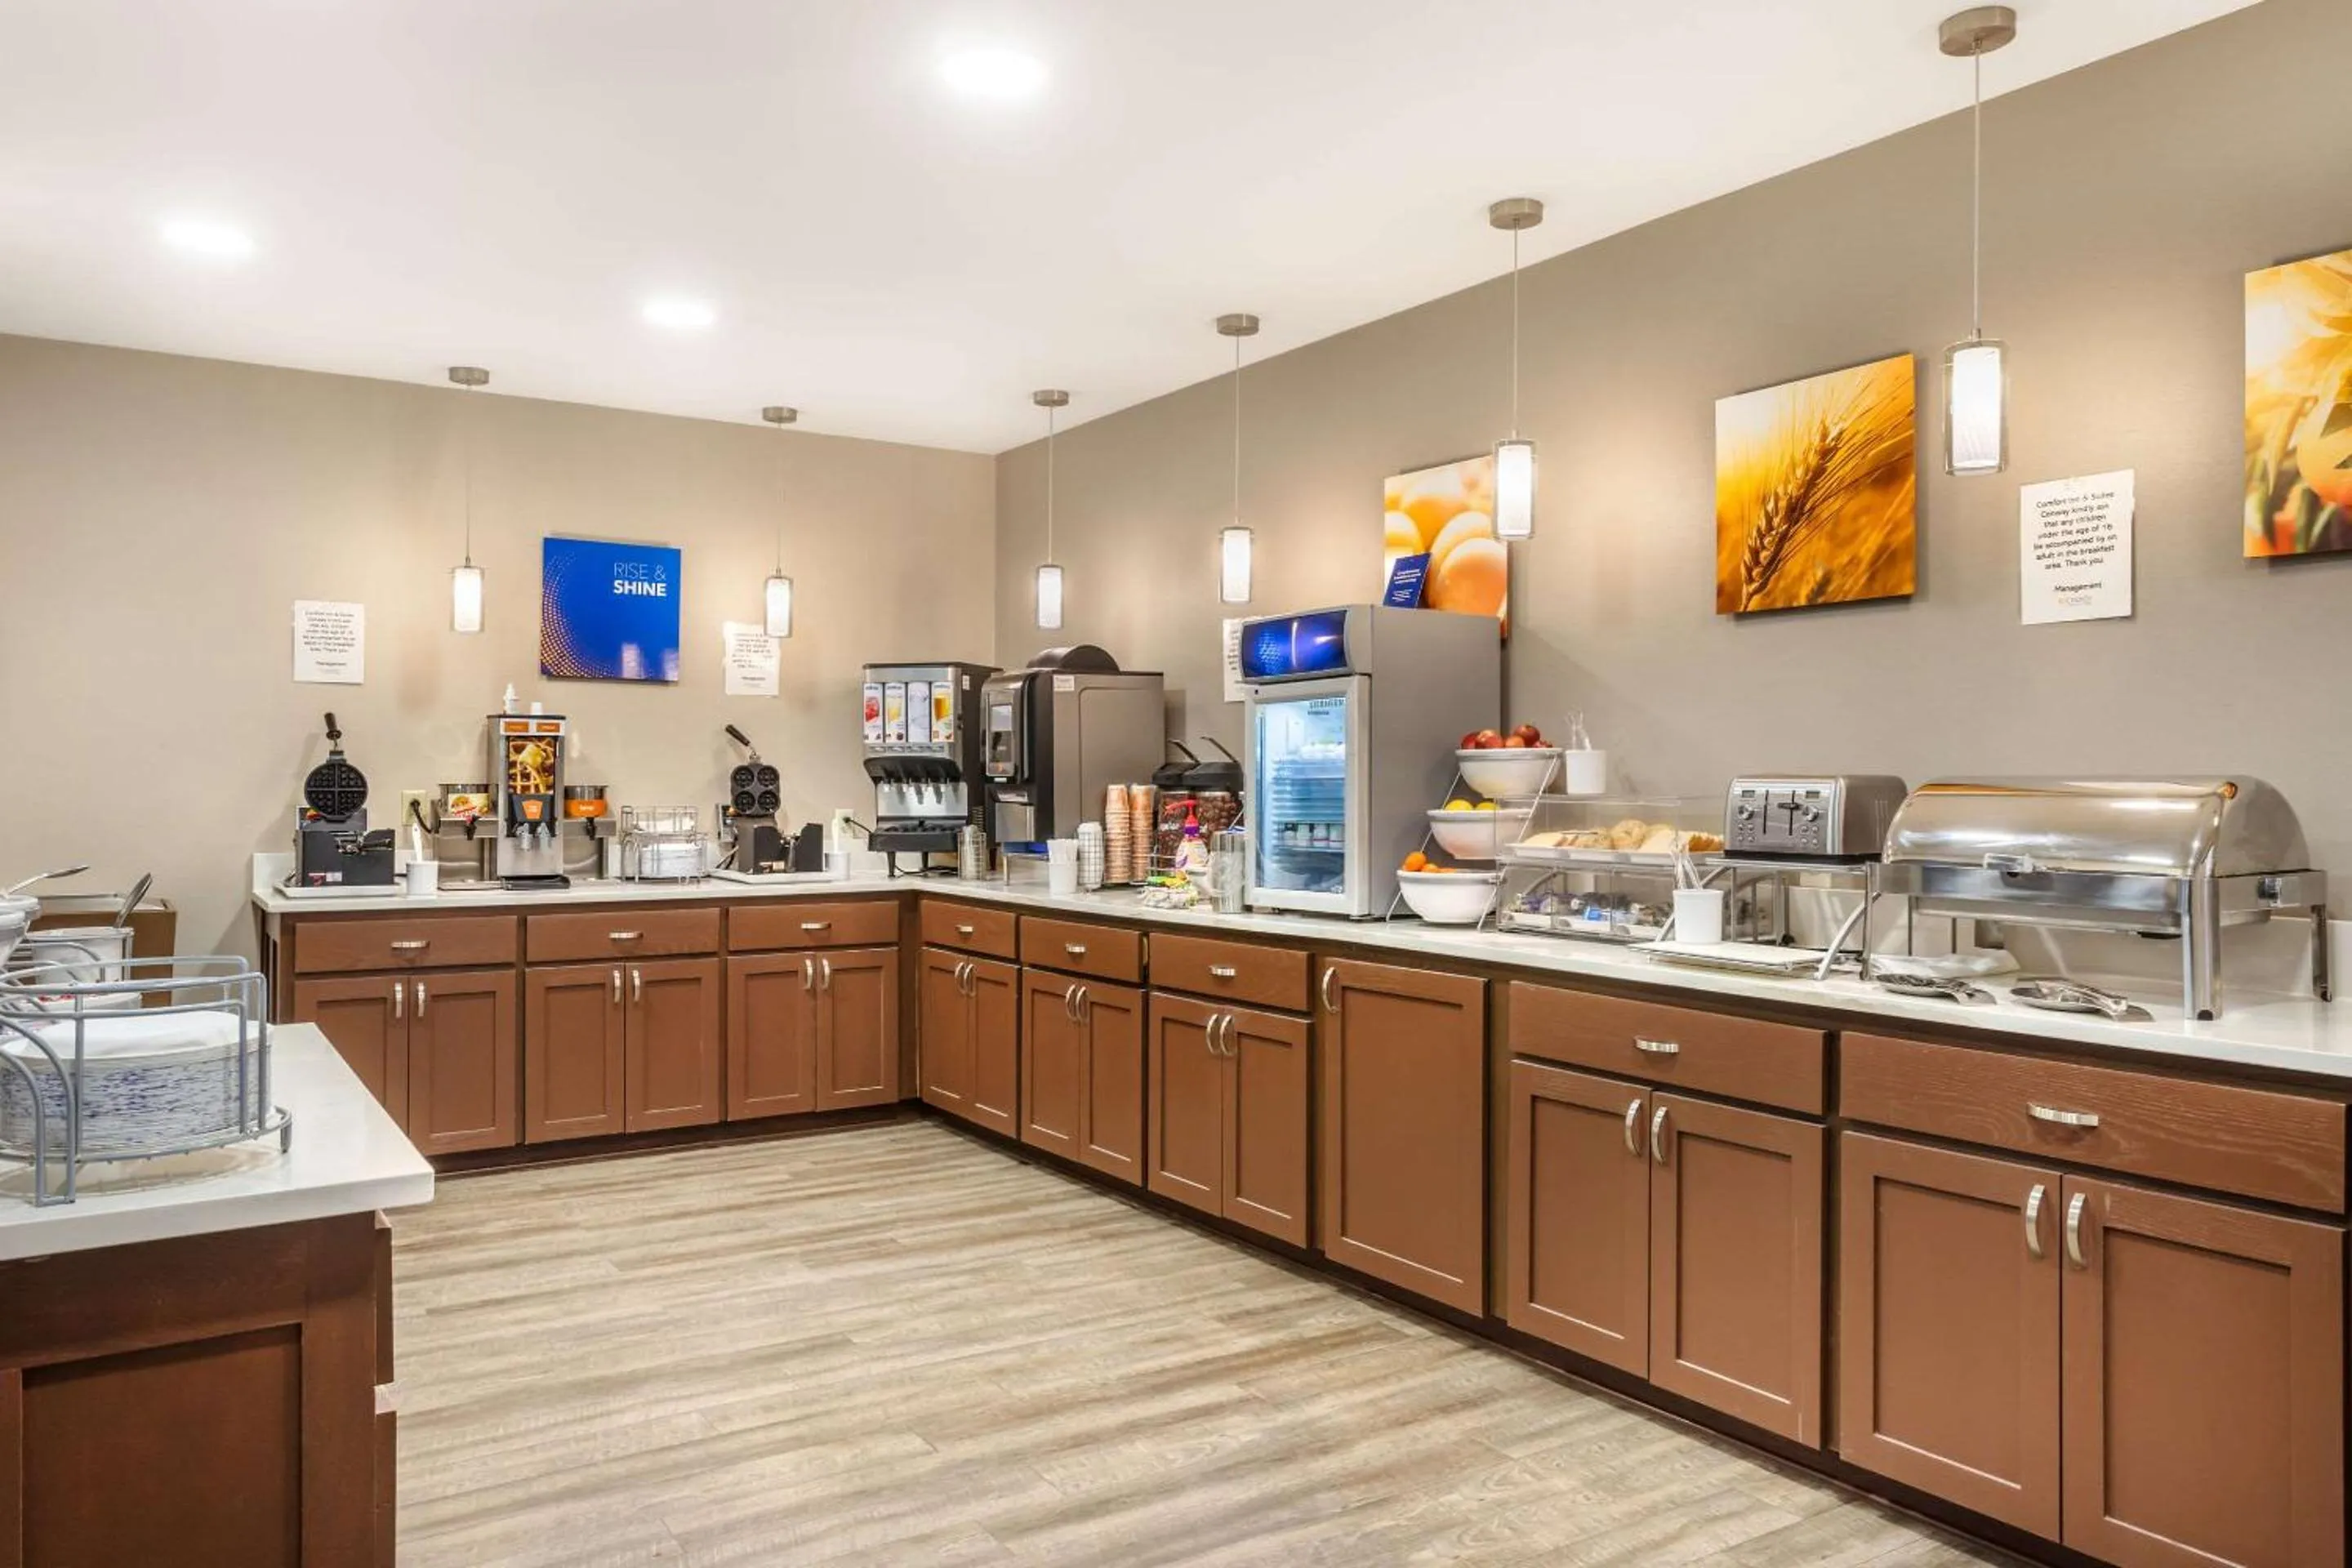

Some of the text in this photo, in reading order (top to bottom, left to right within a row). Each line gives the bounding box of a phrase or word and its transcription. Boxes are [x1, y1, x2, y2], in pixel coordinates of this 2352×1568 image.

[2044, 520, 2058, 528] that
[2060, 519, 2074, 527] any
[2061, 528, 2074, 537] the
[2075, 527, 2089, 536] age
[2065, 559, 2087, 568] Thank
[613, 561, 667, 581] RISE &
[613, 579, 667, 597] SHINE
[2054, 581, 2102, 593] Management
